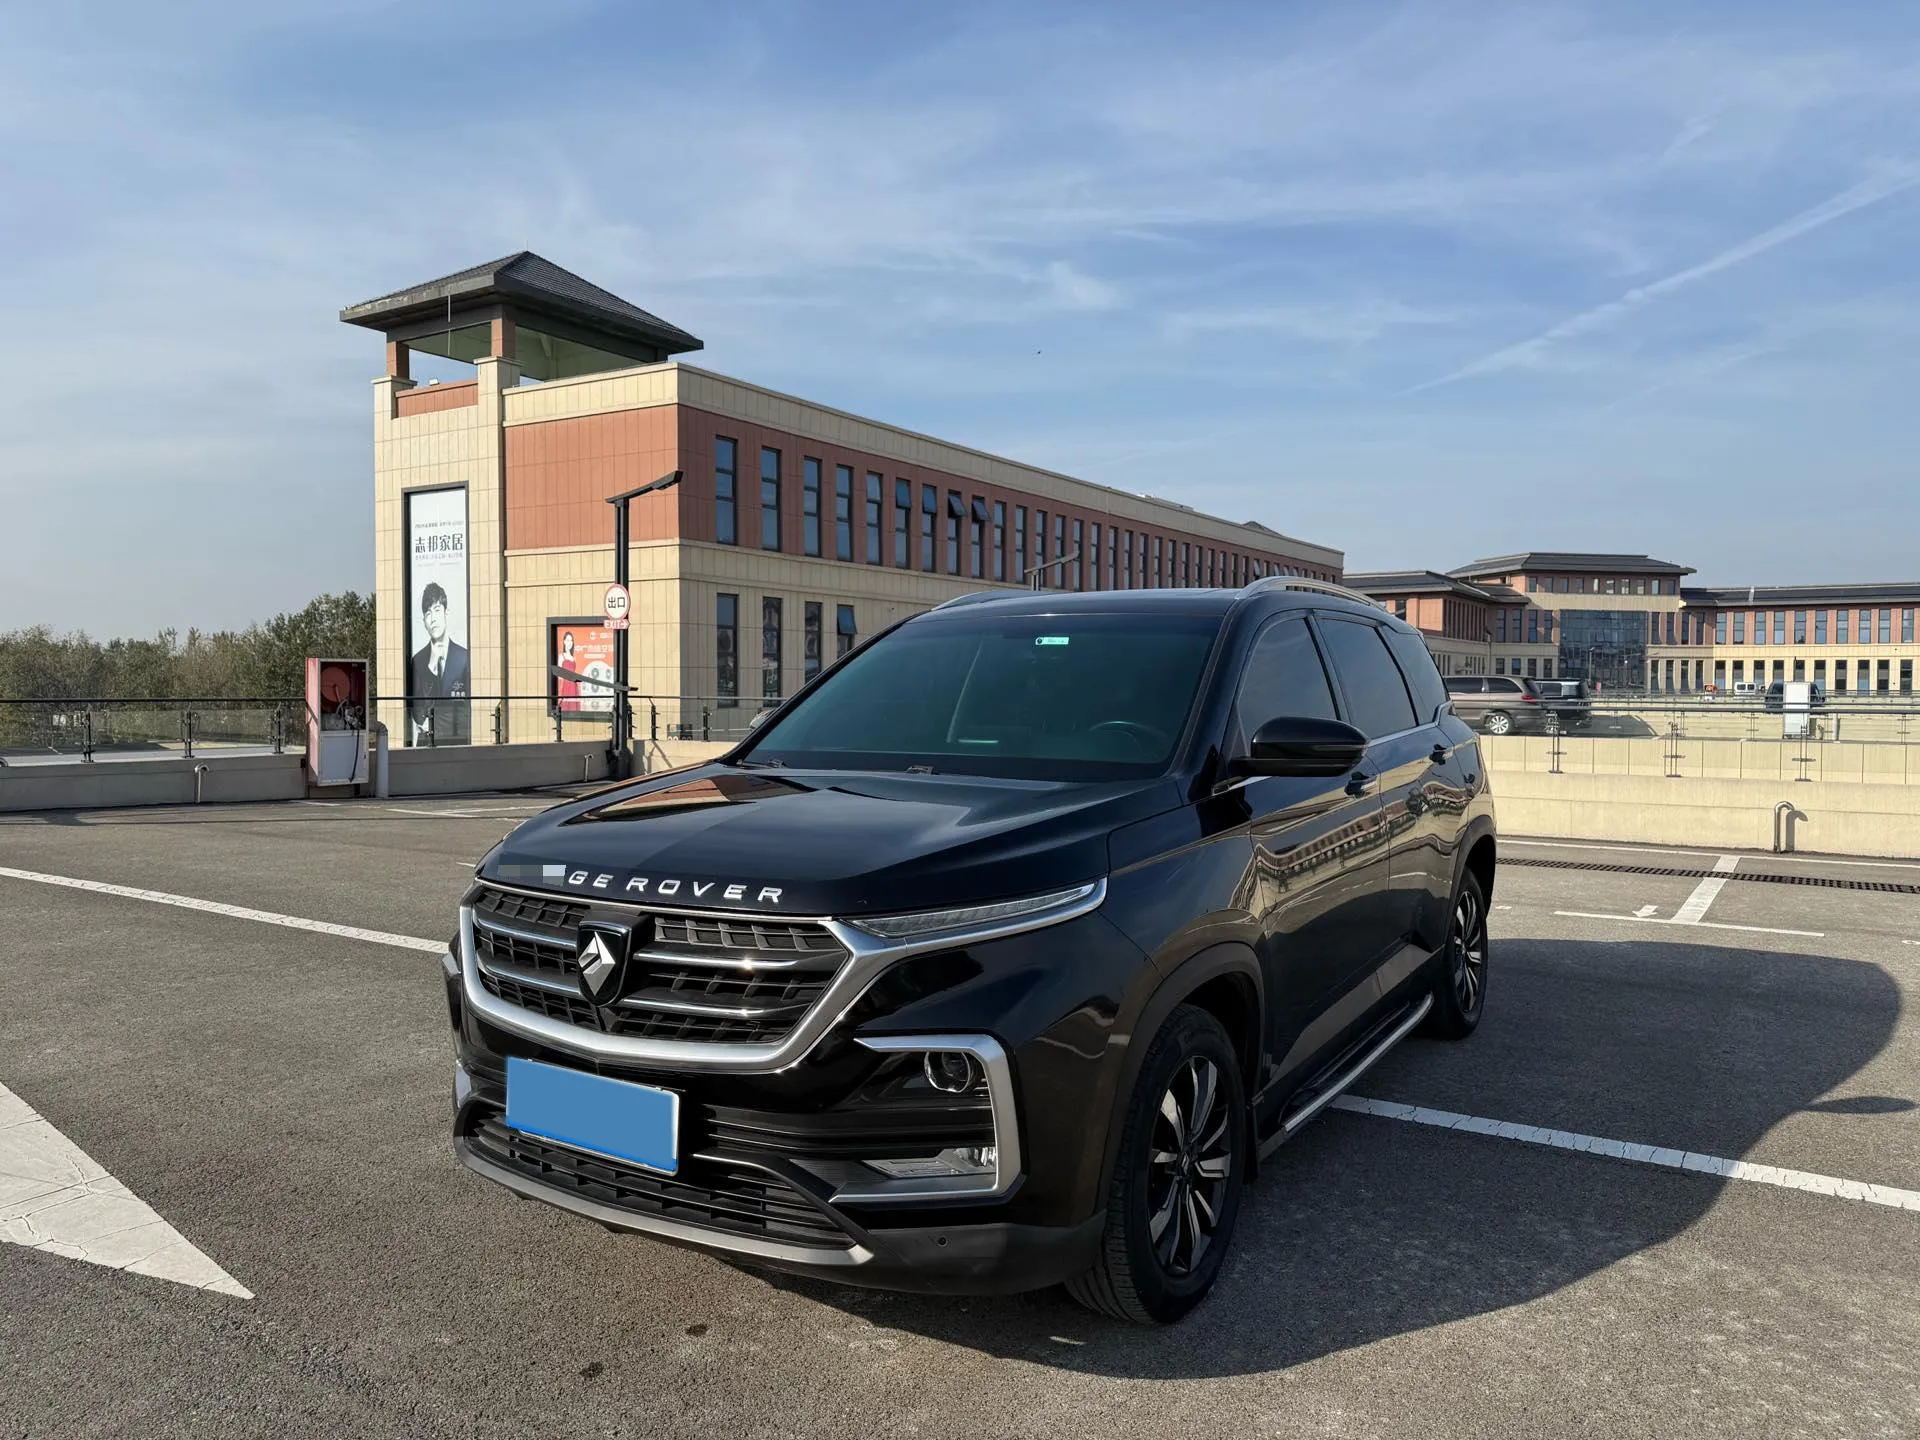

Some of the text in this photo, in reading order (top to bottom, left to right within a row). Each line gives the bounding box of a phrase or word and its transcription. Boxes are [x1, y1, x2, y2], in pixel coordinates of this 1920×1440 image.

[415, 533, 463, 553] 志邦家居
[608, 596, 625, 608] 出口
[604, 619, 621, 629] EXIT
